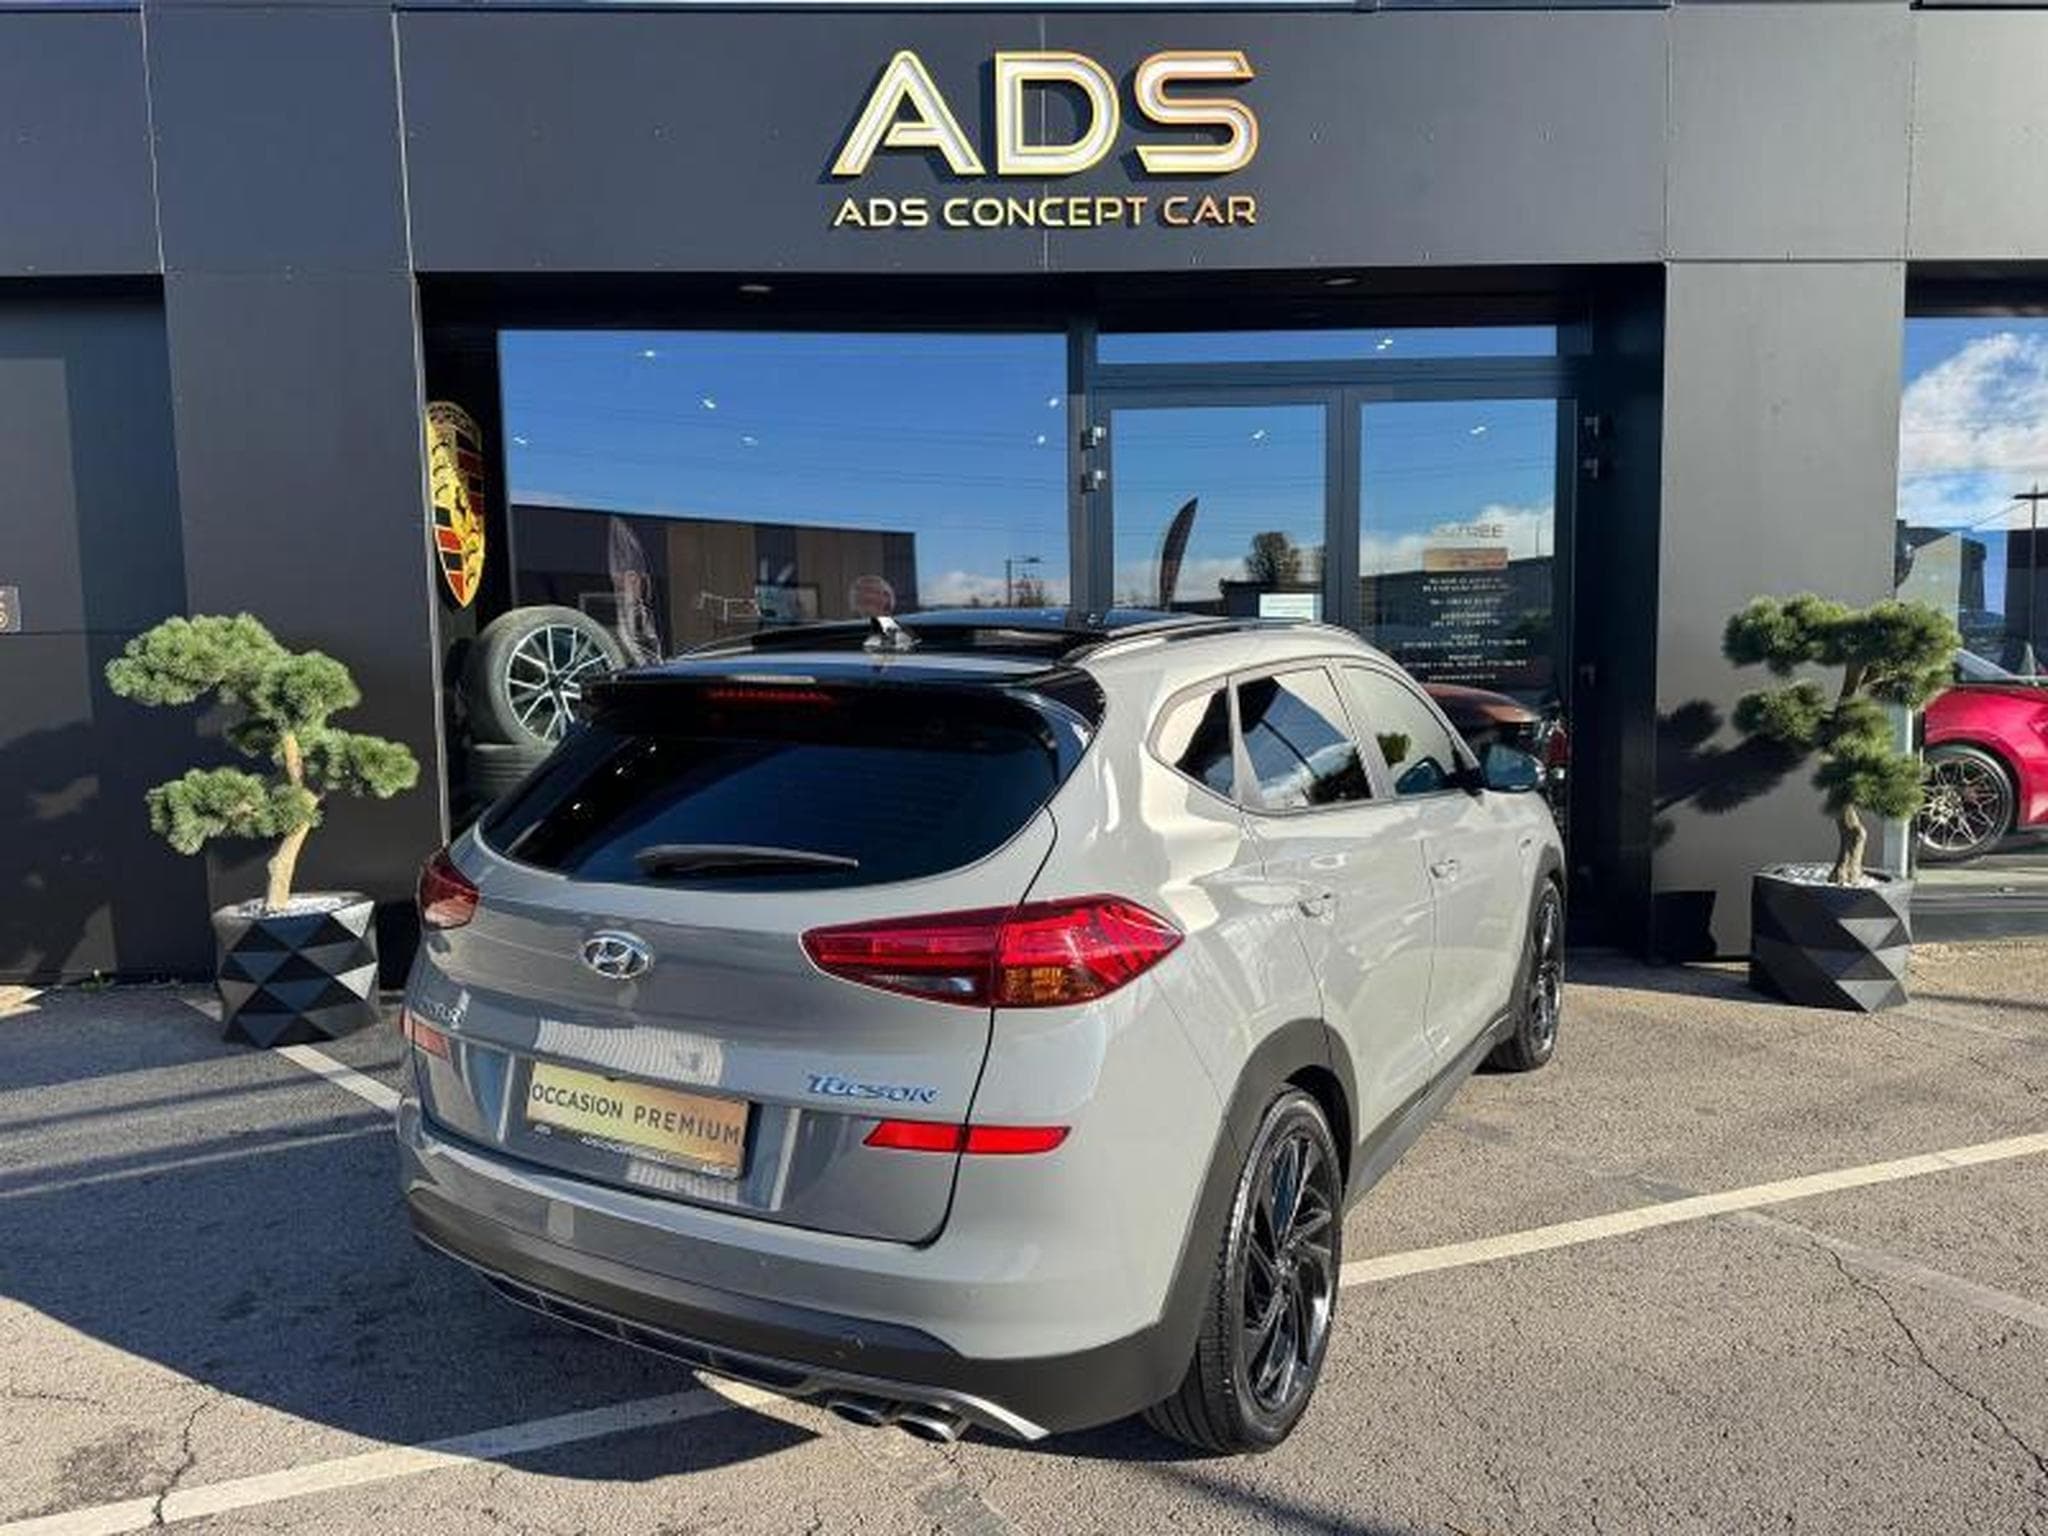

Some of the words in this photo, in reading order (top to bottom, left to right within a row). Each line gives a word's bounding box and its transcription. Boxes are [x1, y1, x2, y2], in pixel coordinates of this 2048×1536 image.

[830, 50, 1259, 176] ADS
[833, 198, 929, 228] ADS
[942, 197, 1148, 227] CONCEPT
[1163, 196, 1257, 225] CAR
[531, 1082, 624, 1120] OCCASION
[633, 1104, 741, 1146] PREMIUM
